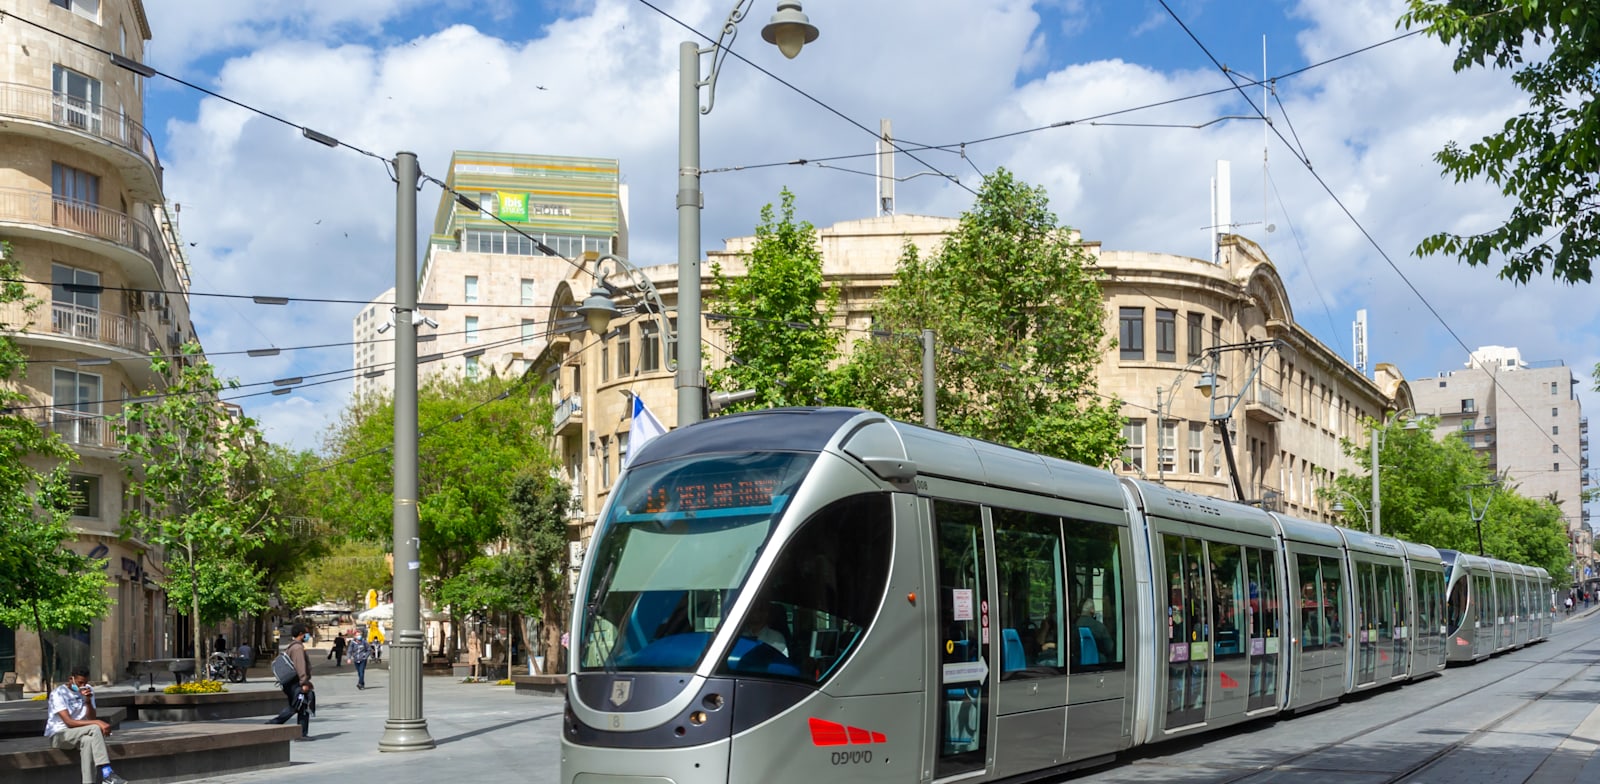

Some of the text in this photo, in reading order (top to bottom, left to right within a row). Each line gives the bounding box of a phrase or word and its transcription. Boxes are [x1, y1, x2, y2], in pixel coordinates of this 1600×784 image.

[504, 196, 522, 208] ibis
[533, 203, 572, 216] HOTEL
[612, 715, 621, 728] 8
[831, 750, 873, 765] סיטיפס
